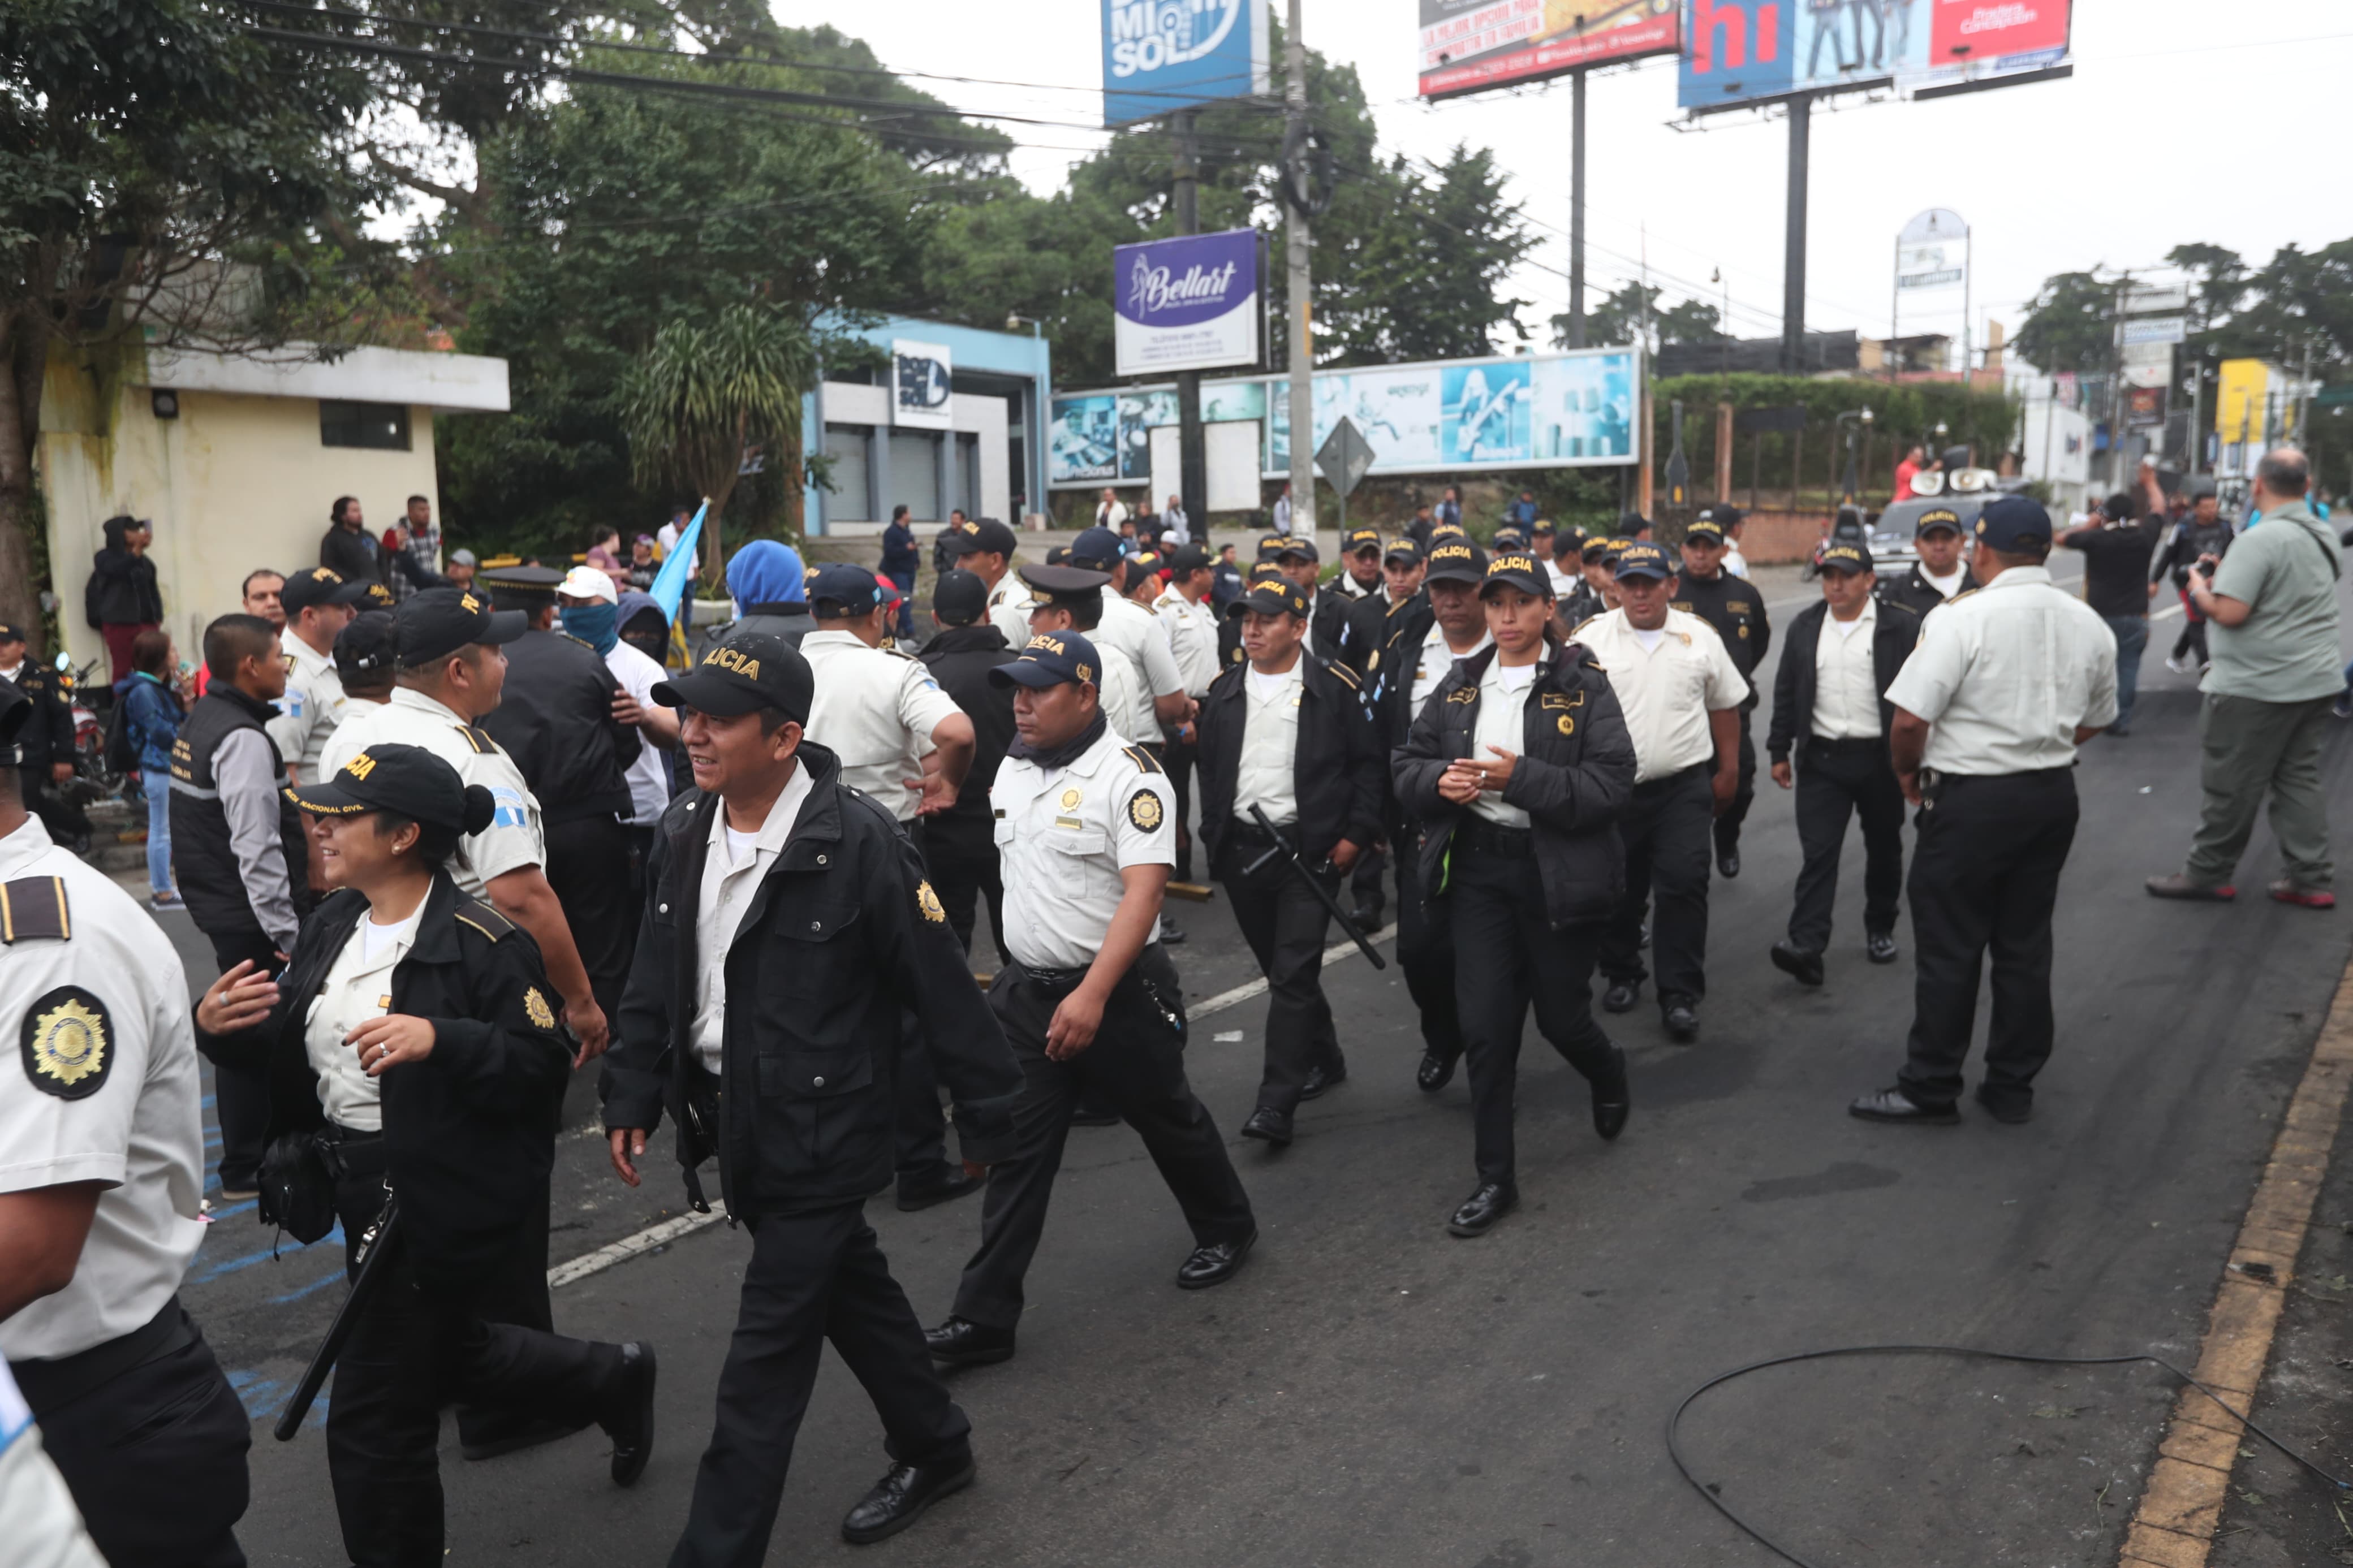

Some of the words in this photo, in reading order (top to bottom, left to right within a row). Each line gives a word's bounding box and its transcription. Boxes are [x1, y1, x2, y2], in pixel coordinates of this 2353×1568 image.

[1146, 260, 1237, 312] Bellart
[1430, 545, 1471, 561] POLICIA
[1486, 556, 1533, 577] POLICIA
[300, 801, 341, 813] NACIONAL
